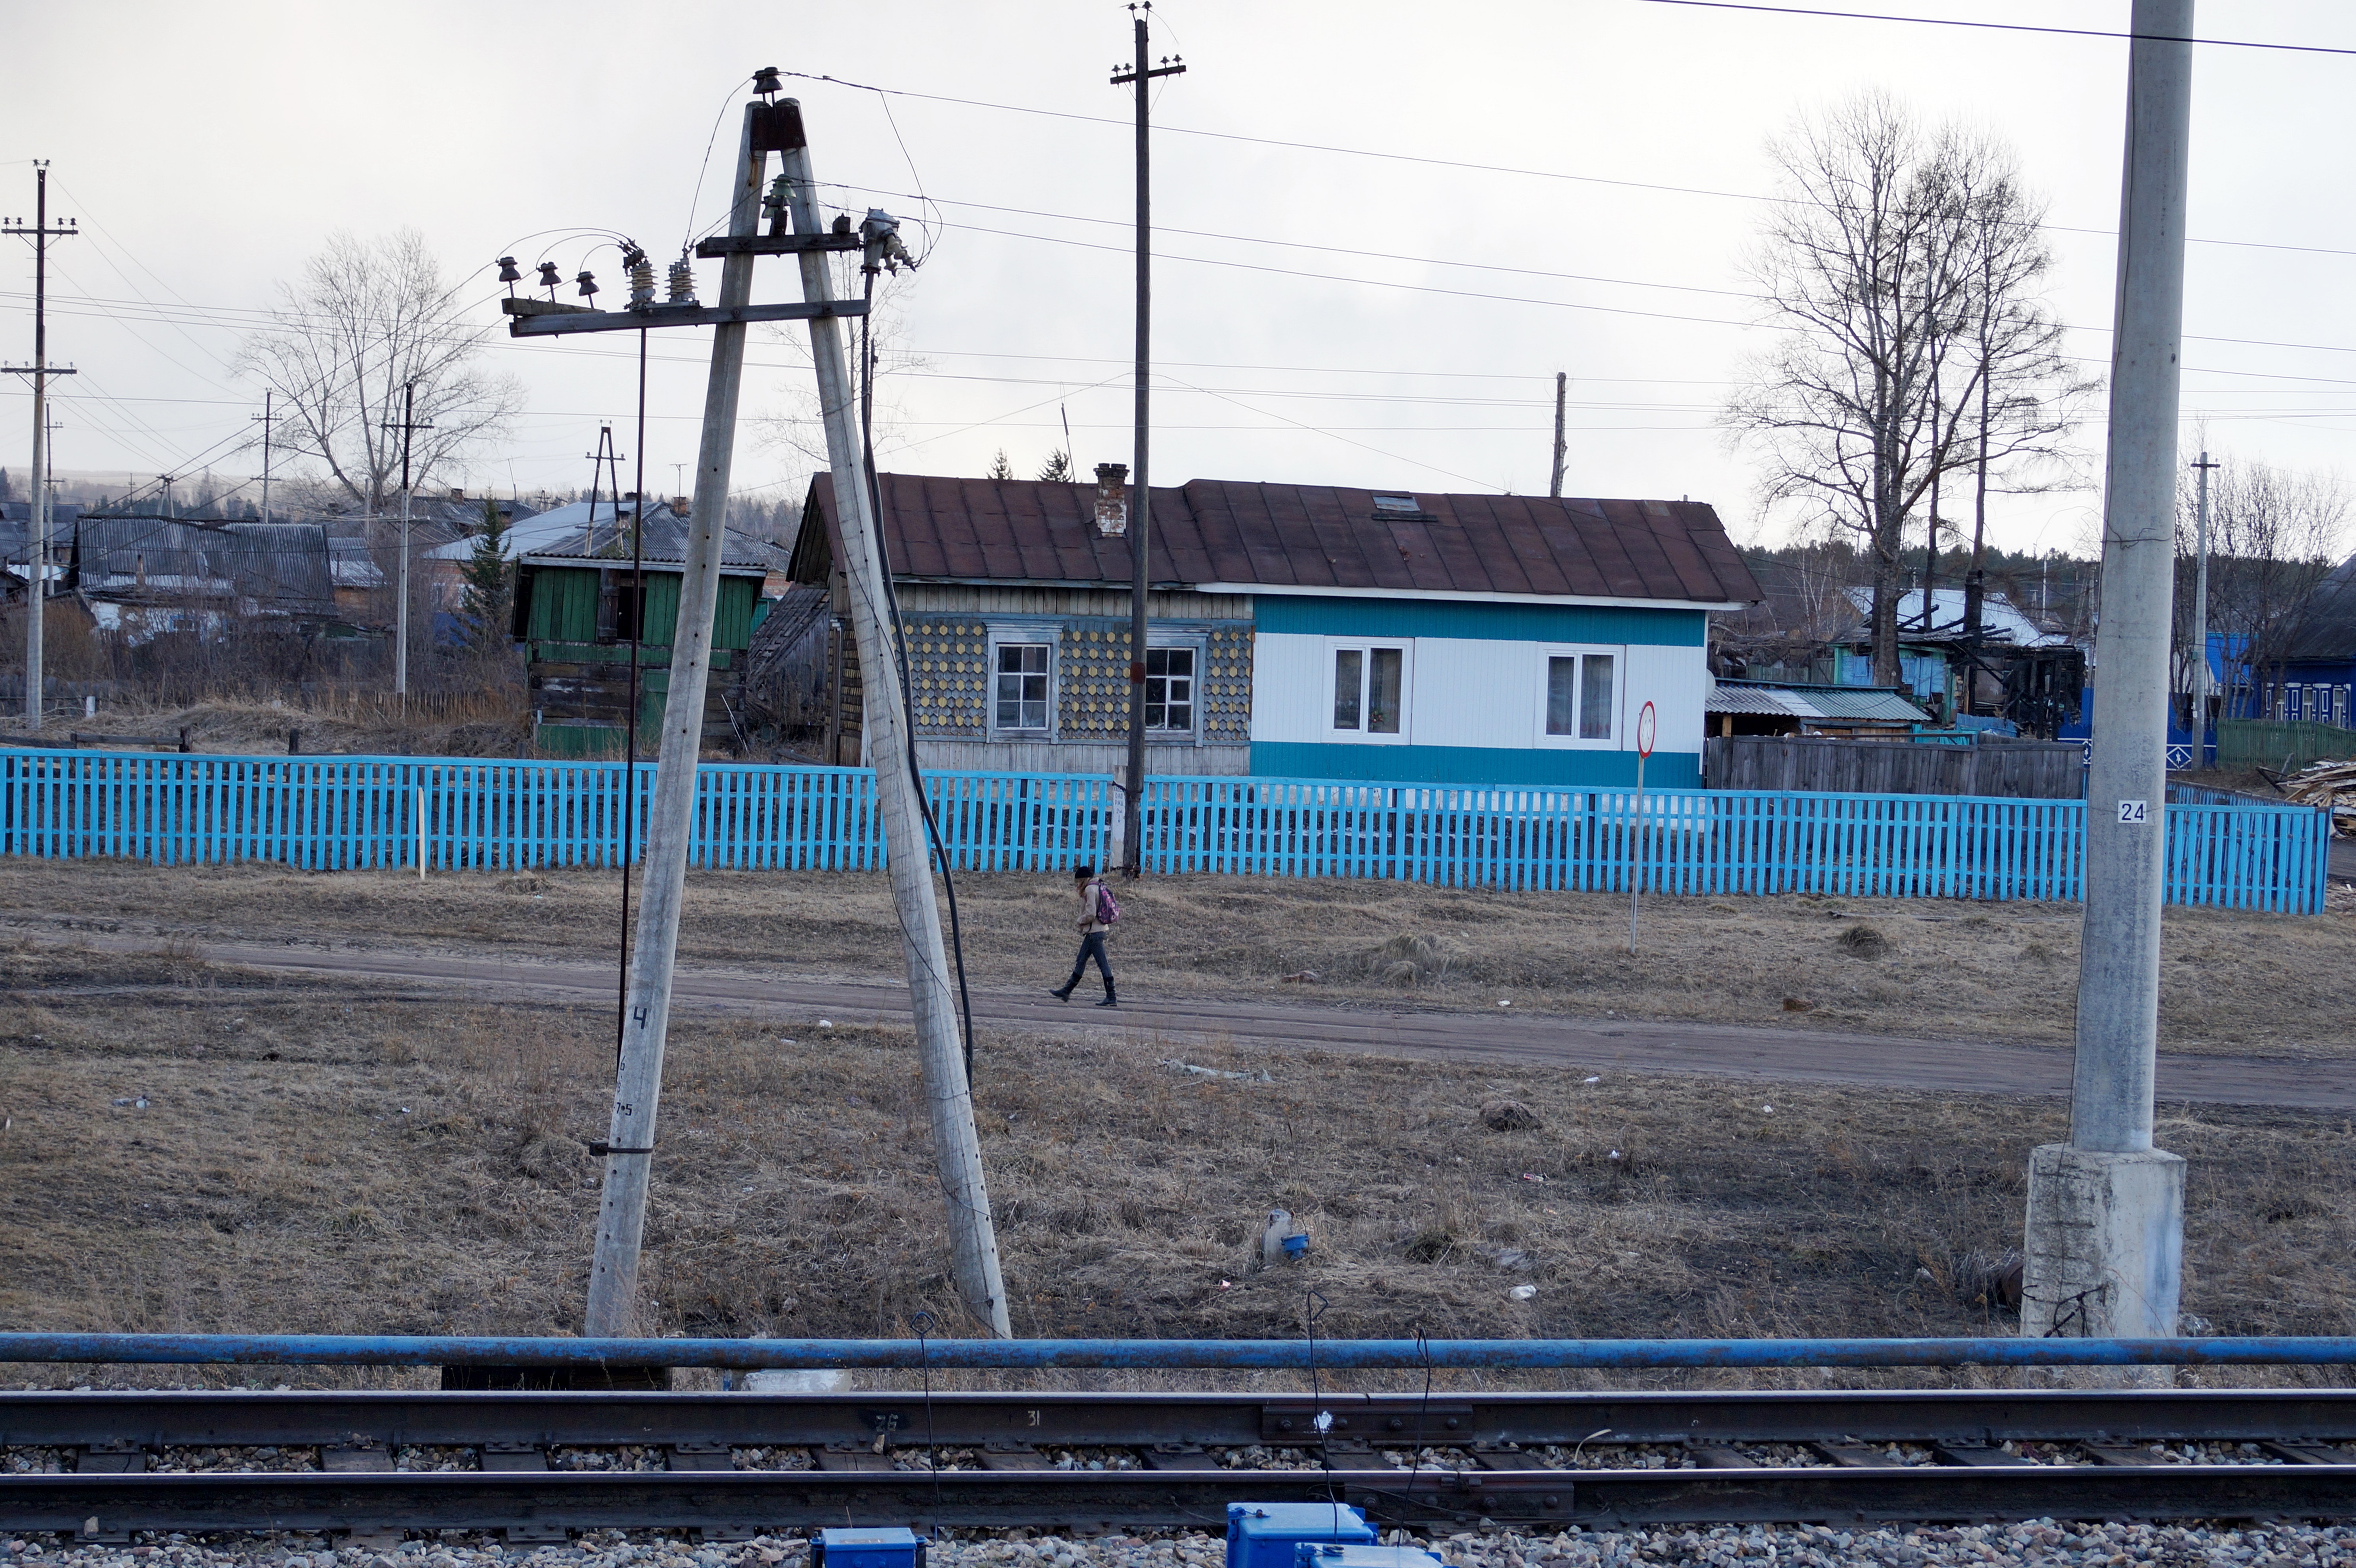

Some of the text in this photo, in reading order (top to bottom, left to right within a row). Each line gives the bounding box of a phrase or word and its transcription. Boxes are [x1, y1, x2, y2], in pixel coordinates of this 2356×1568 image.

[2121, 803, 2144, 821] 24
[633, 1006, 647, 1030] 4
[1028, 1410, 1040, 1426] 31
